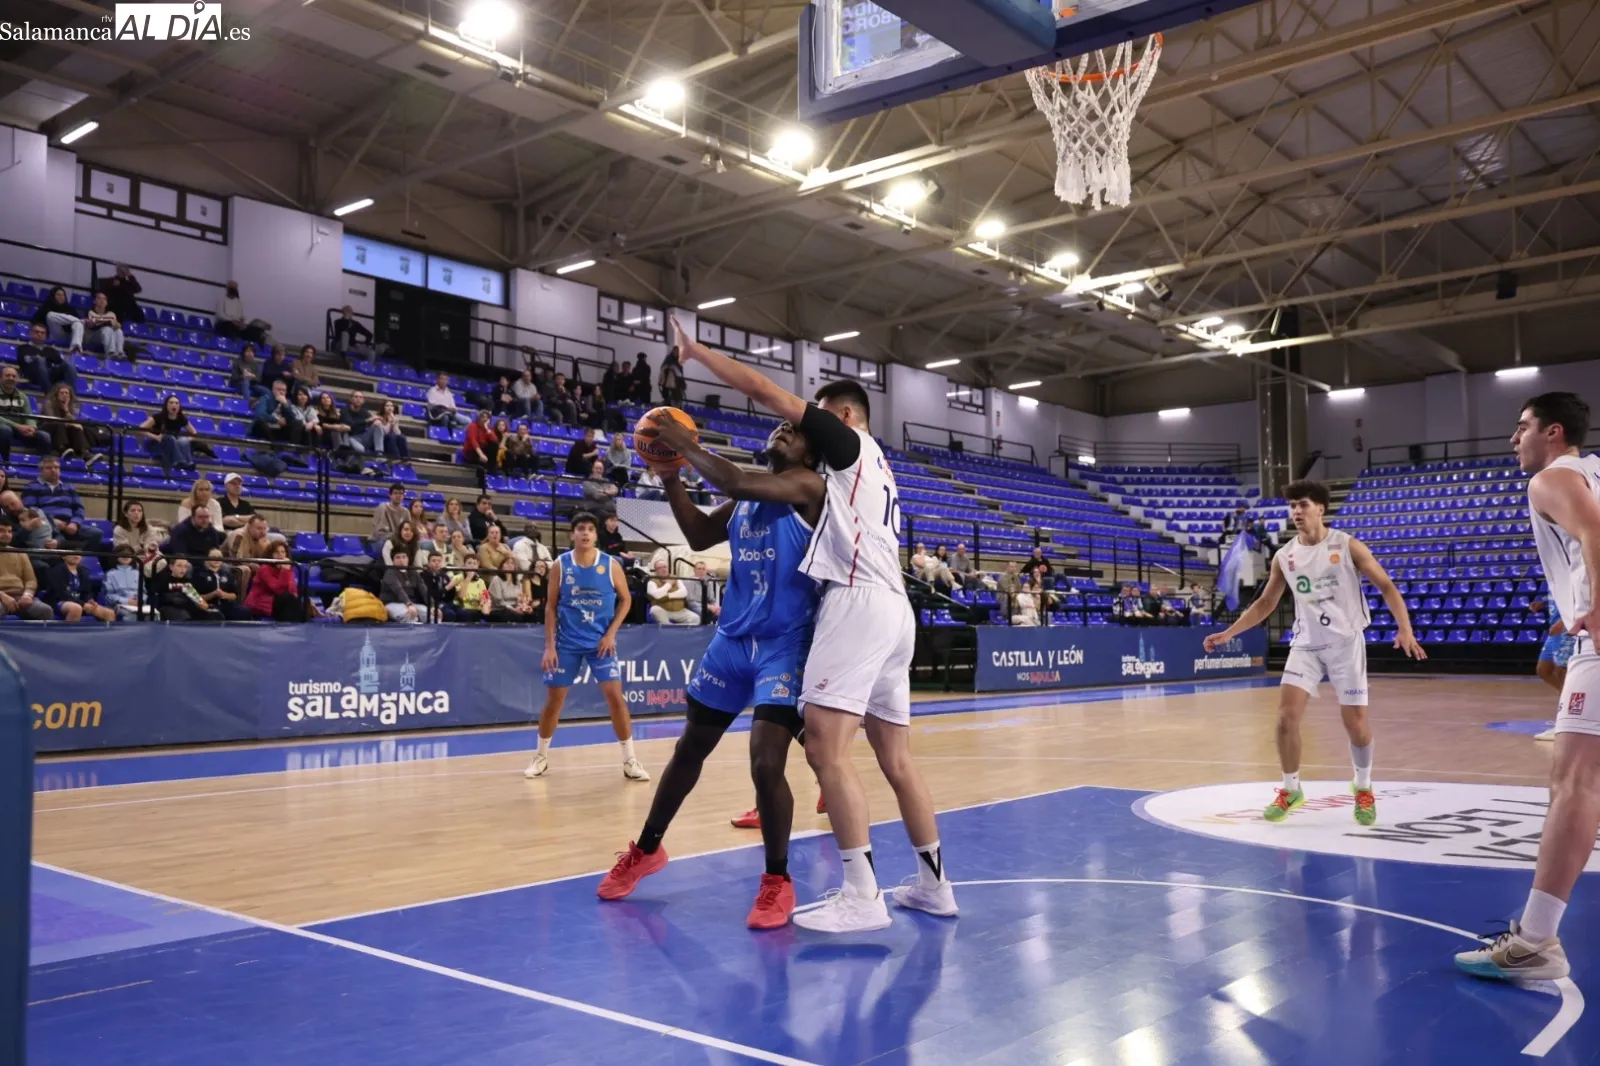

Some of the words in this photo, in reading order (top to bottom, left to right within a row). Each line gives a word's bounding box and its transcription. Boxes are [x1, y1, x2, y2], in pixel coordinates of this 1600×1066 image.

[1319, 612, 1331, 627] 6
[992, 650, 1044, 667] CASTILLA
[1048, 651, 1054, 669] Y
[1057, 645, 1084, 665] LEÓN
[681, 659, 695, 686] Y
[288, 679, 342, 695] turismo
